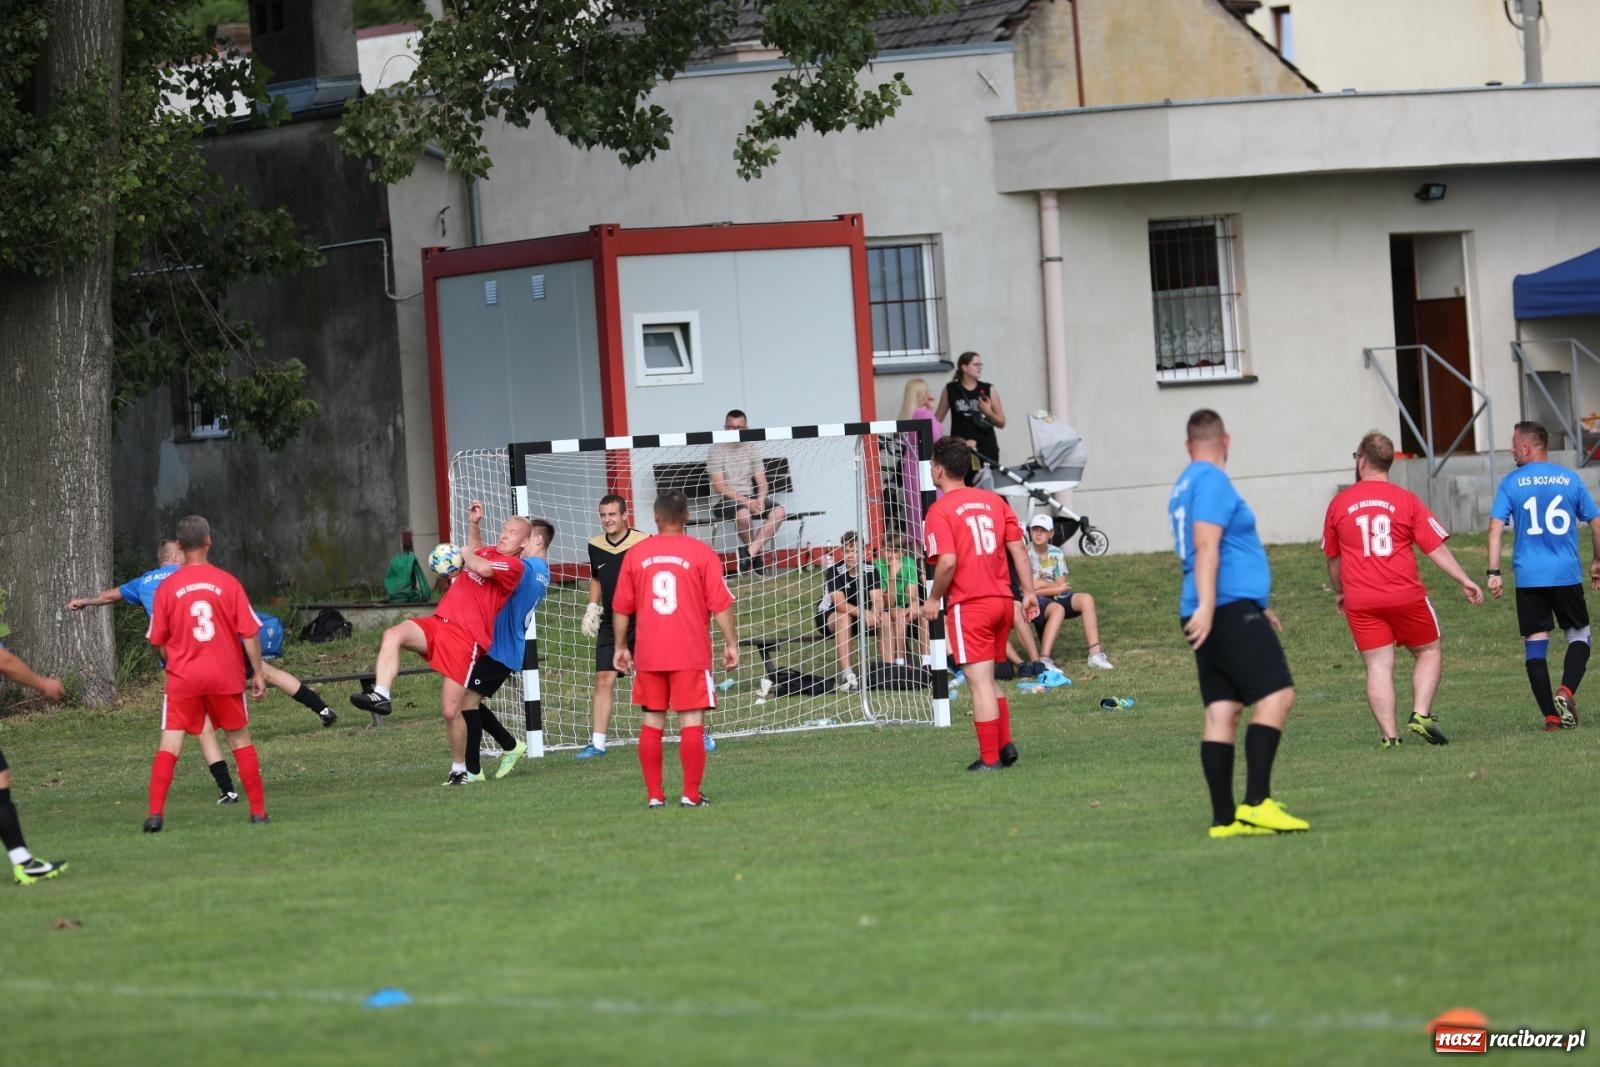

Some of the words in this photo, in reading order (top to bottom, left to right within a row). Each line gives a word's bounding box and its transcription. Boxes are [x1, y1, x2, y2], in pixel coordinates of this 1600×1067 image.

[1518, 476, 1531, 487] LKS
[1533, 473, 1570, 486] BOJANÓW
[964, 514, 997, 556] 16
[1355, 514, 1393, 557] 18
[1523, 494, 1571, 536] 16
[652, 571, 678, 616] 9
[189, 600, 216, 643] 3
